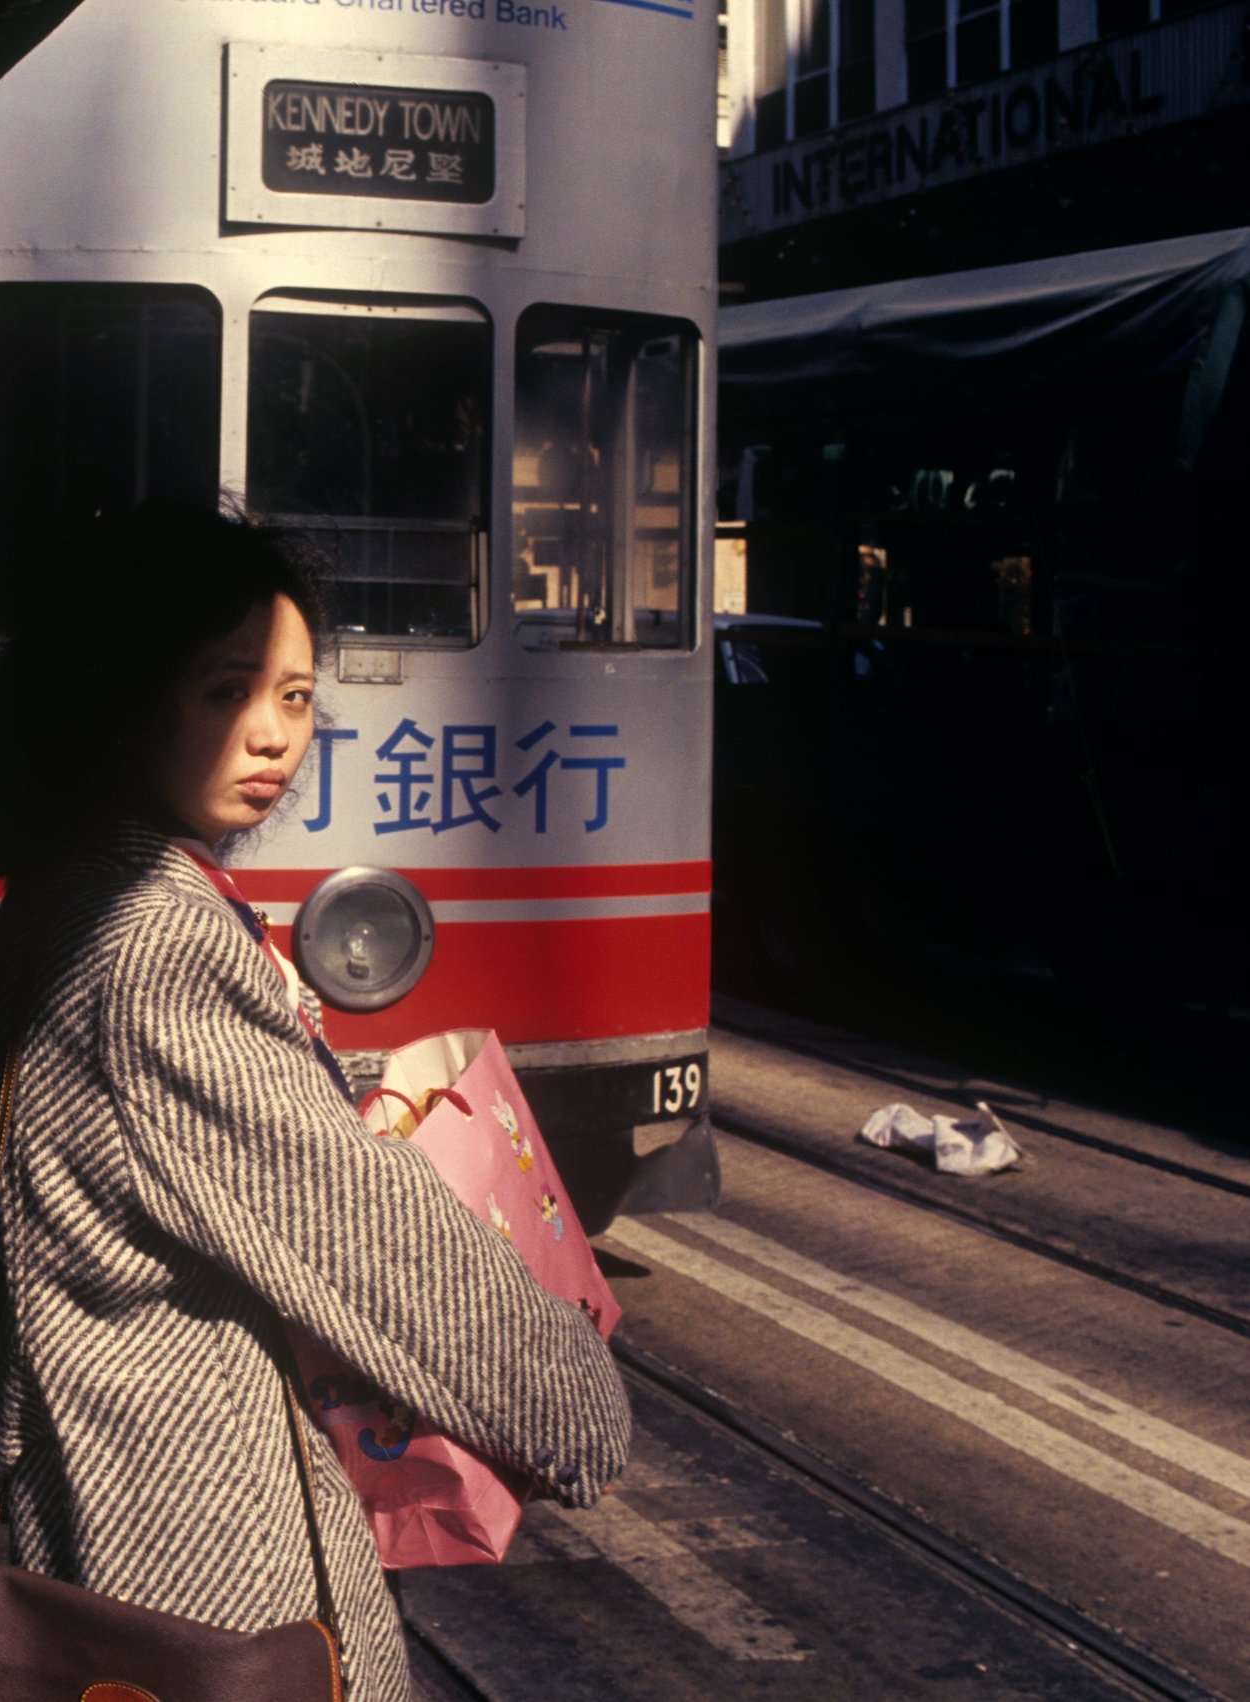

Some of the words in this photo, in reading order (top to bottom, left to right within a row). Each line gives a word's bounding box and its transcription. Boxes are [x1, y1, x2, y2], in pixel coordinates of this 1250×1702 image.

[496, 0, 567, 30] Bank
[266, 93, 390, 137] KENNEDY
[398, 100, 482, 145] TOWN
[771, 49, 1165, 217] INTERNATIONAL
[653, 1063, 702, 1114] 139
